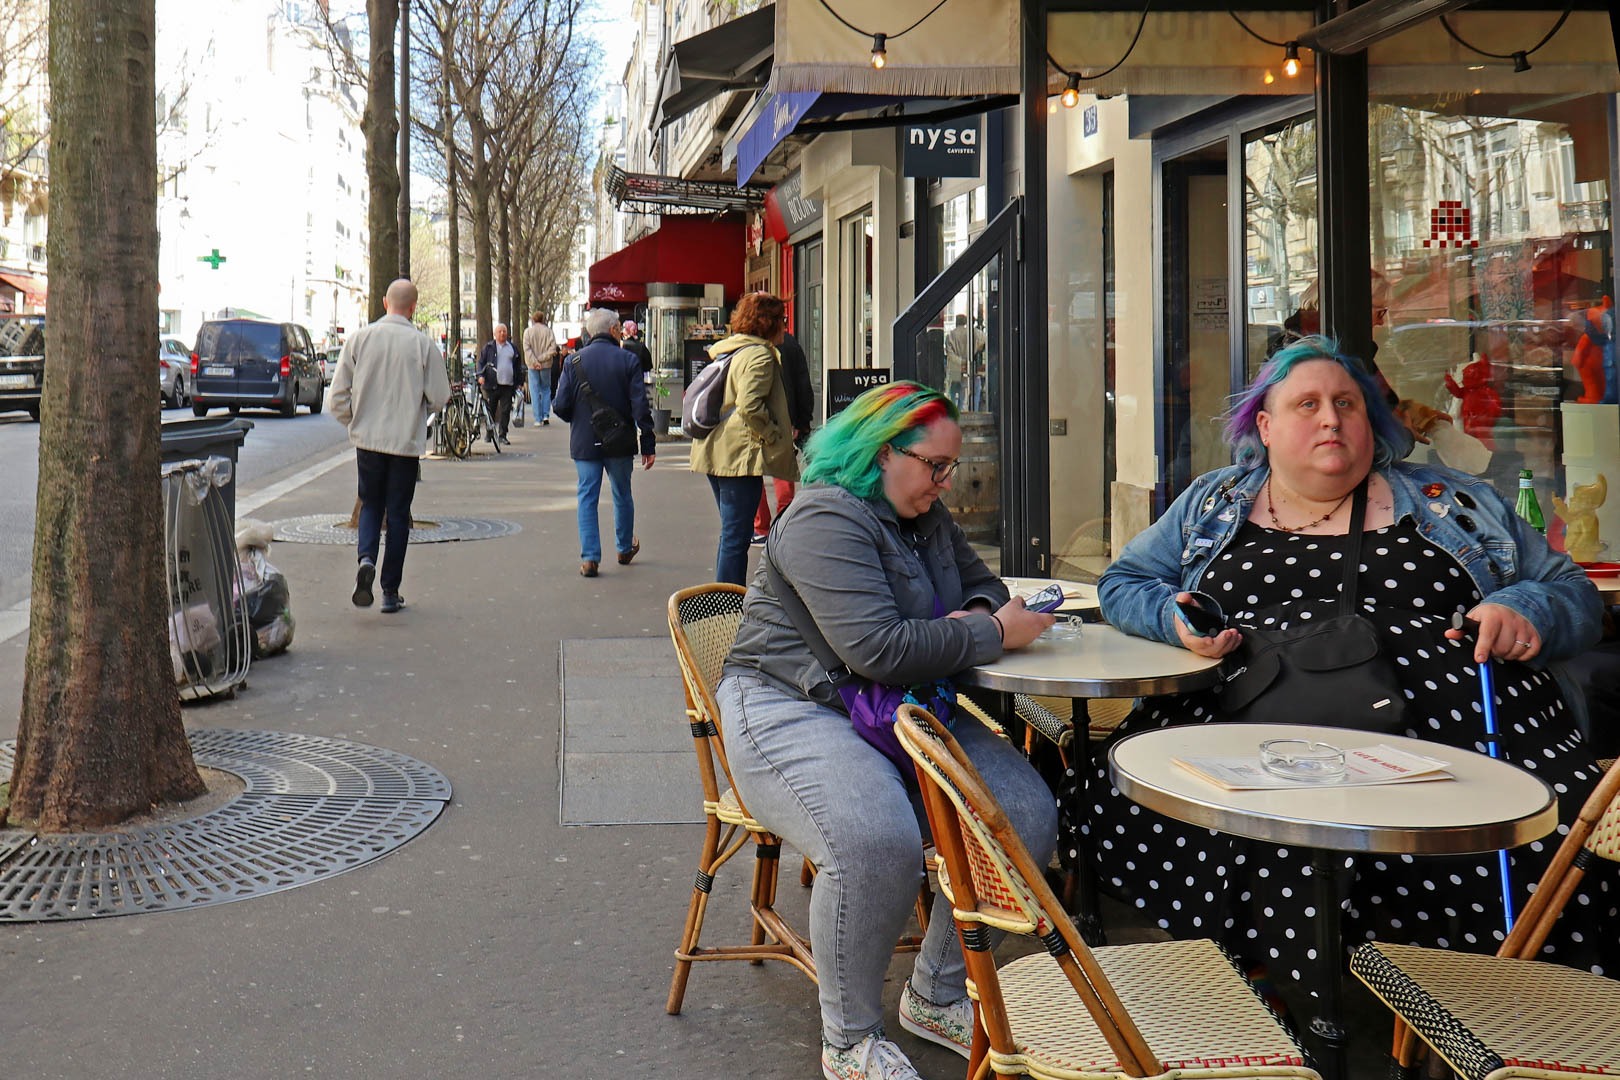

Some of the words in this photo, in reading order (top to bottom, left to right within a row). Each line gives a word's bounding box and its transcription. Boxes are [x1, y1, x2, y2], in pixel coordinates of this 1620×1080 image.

[1085, 105, 1096, 133] 35
[910, 128, 976, 150] nysa
[854, 375, 887, 386] nysa
